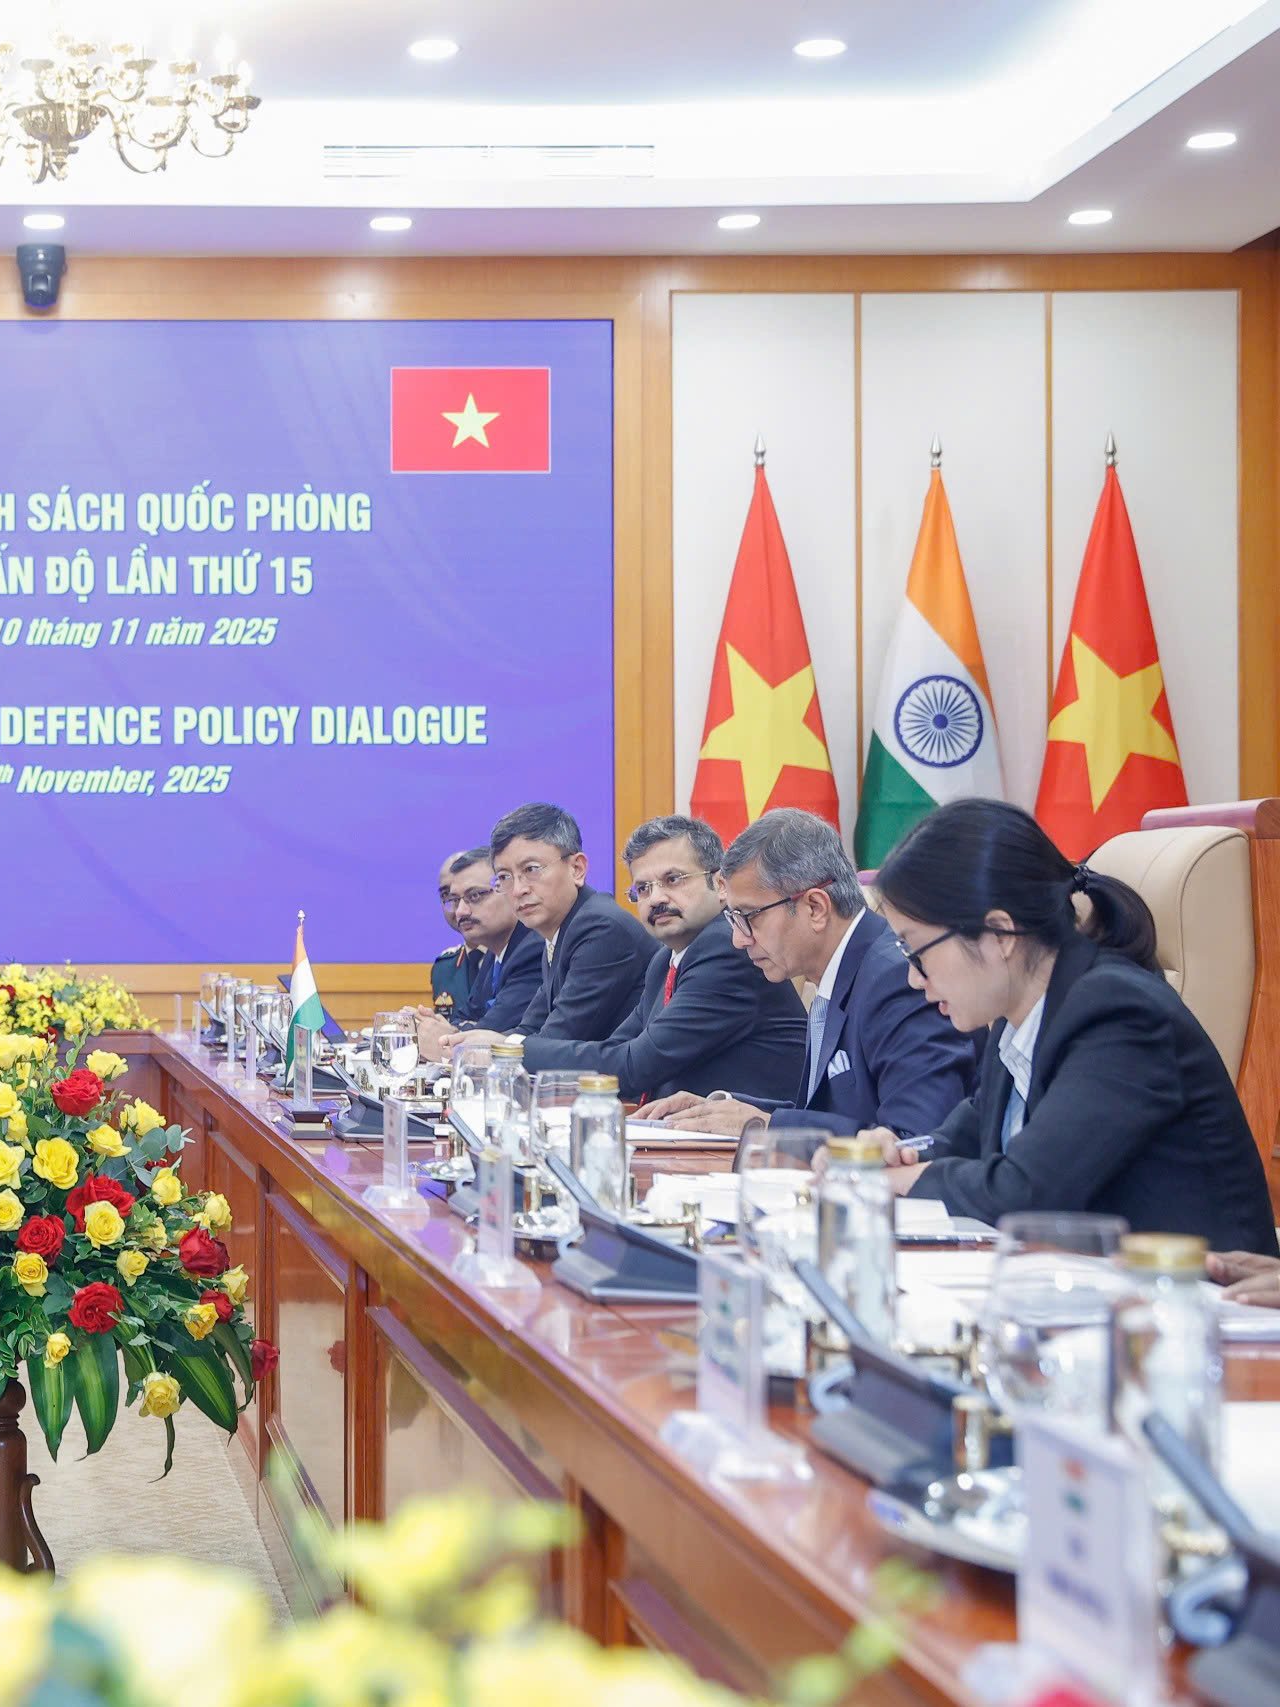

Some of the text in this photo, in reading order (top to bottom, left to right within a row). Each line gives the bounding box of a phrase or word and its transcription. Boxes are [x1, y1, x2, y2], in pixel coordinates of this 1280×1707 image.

[25, 484, 125, 532] SÁCH
[136, 479, 235, 536] QUỐC
[246, 483, 372, 532] PHÒNG
[44, 547, 95, 603] ĐỘ
[106, 543, 177, 595] LẦN
[187, 547, 262, 595] THỨ
[269, 556, 313, 595] 15
[26, 617, 103, 649] tháng
[109, 617, 141, 646] 11
[144, 616, 204, 646] năm
[209, 617, 280, 646] 2025
[0, 706, 162, 745] DEFENCE
[173, 706, 300, 746] POLICY
[311, 706, 488, 745] DIALOGUE
[16, 764, 156, 797] November,
[162, 765, 233, 794] 2025
